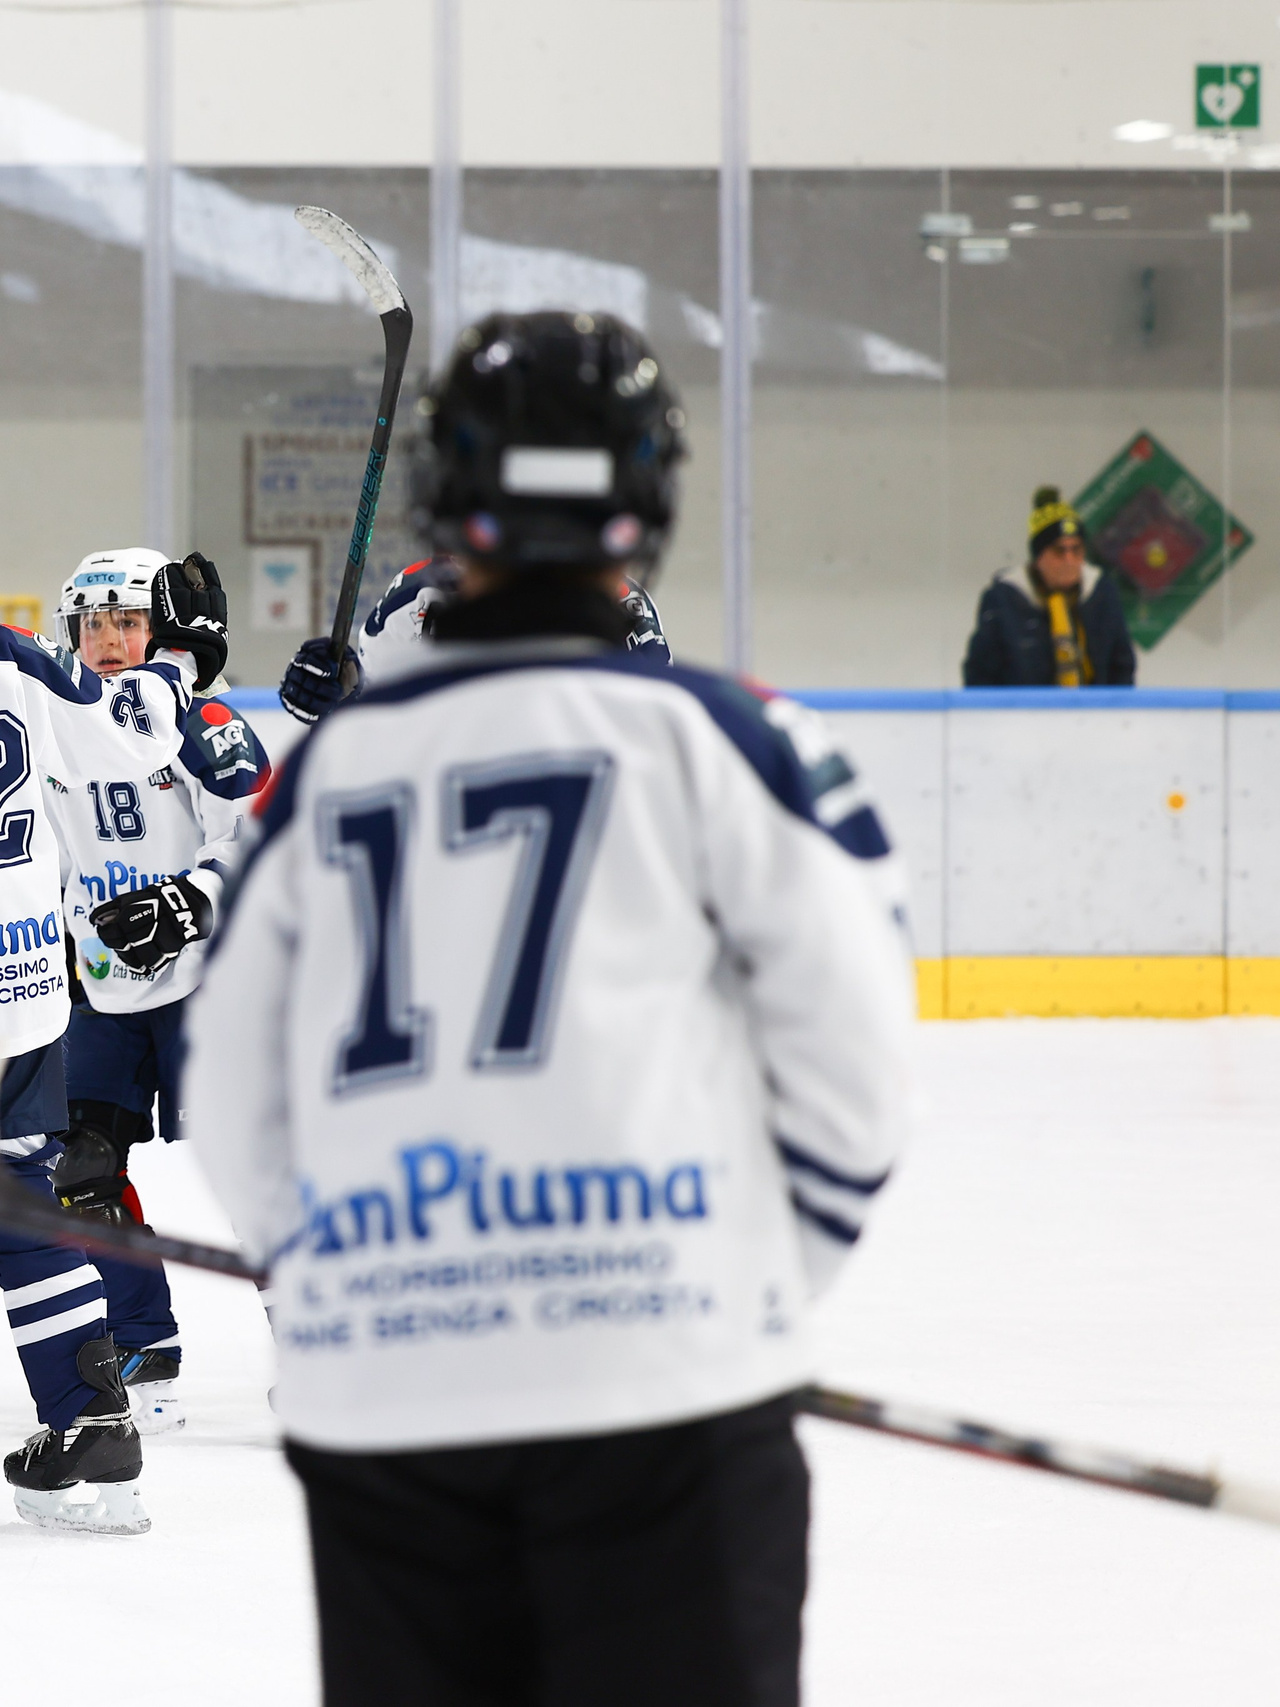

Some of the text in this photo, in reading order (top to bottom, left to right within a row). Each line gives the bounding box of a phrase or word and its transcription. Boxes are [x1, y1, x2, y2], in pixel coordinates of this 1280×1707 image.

[348, 446, 387, 568] BAUER
[87, 573, 115, 583] OTTO
[87, 780, 147, 842] 18
[320, 750, 619, 1104] 17
